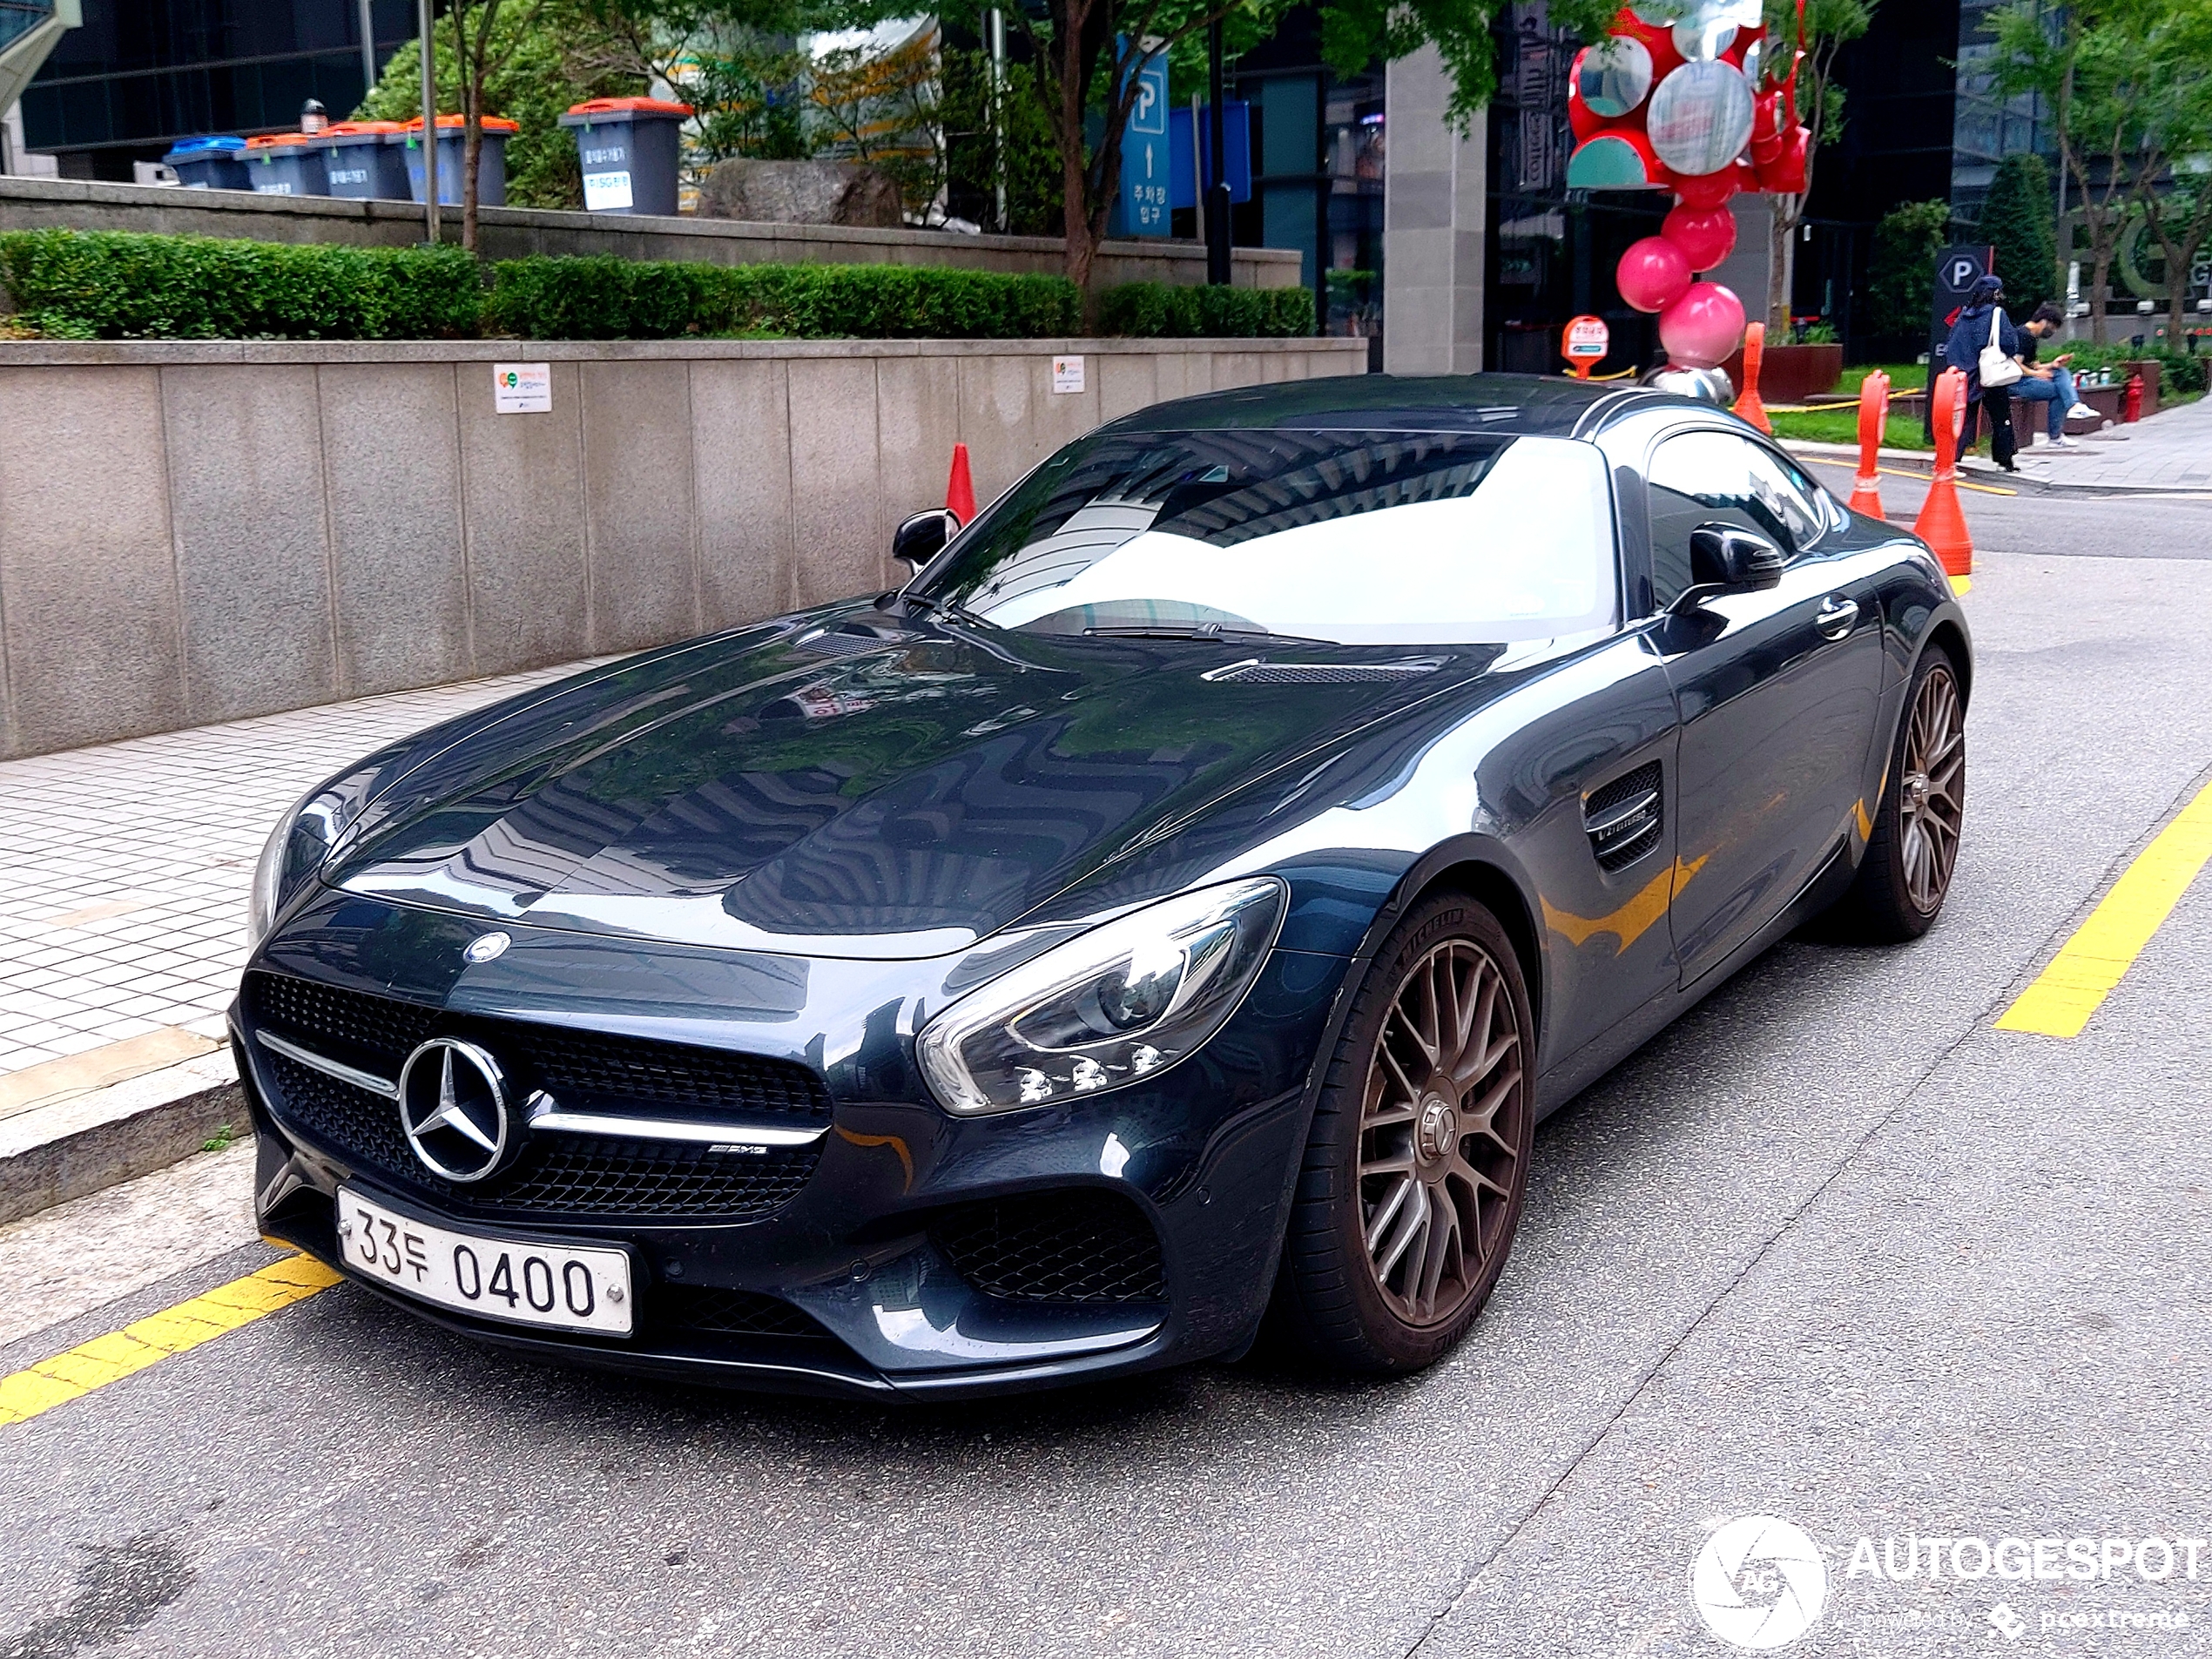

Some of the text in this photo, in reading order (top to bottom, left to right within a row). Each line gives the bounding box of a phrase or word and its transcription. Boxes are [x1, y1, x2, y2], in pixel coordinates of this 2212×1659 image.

[1136, 81, 1156, 120] P
[1135, 185, 1165, 206] 주차장
[1141, 206, 1161, 224] 입구
[1952, 260, 1973, 287] P
[1401, 907, 1464, 962] MICHELIN
[357, 1208, 596, 1318] 33두 0400
